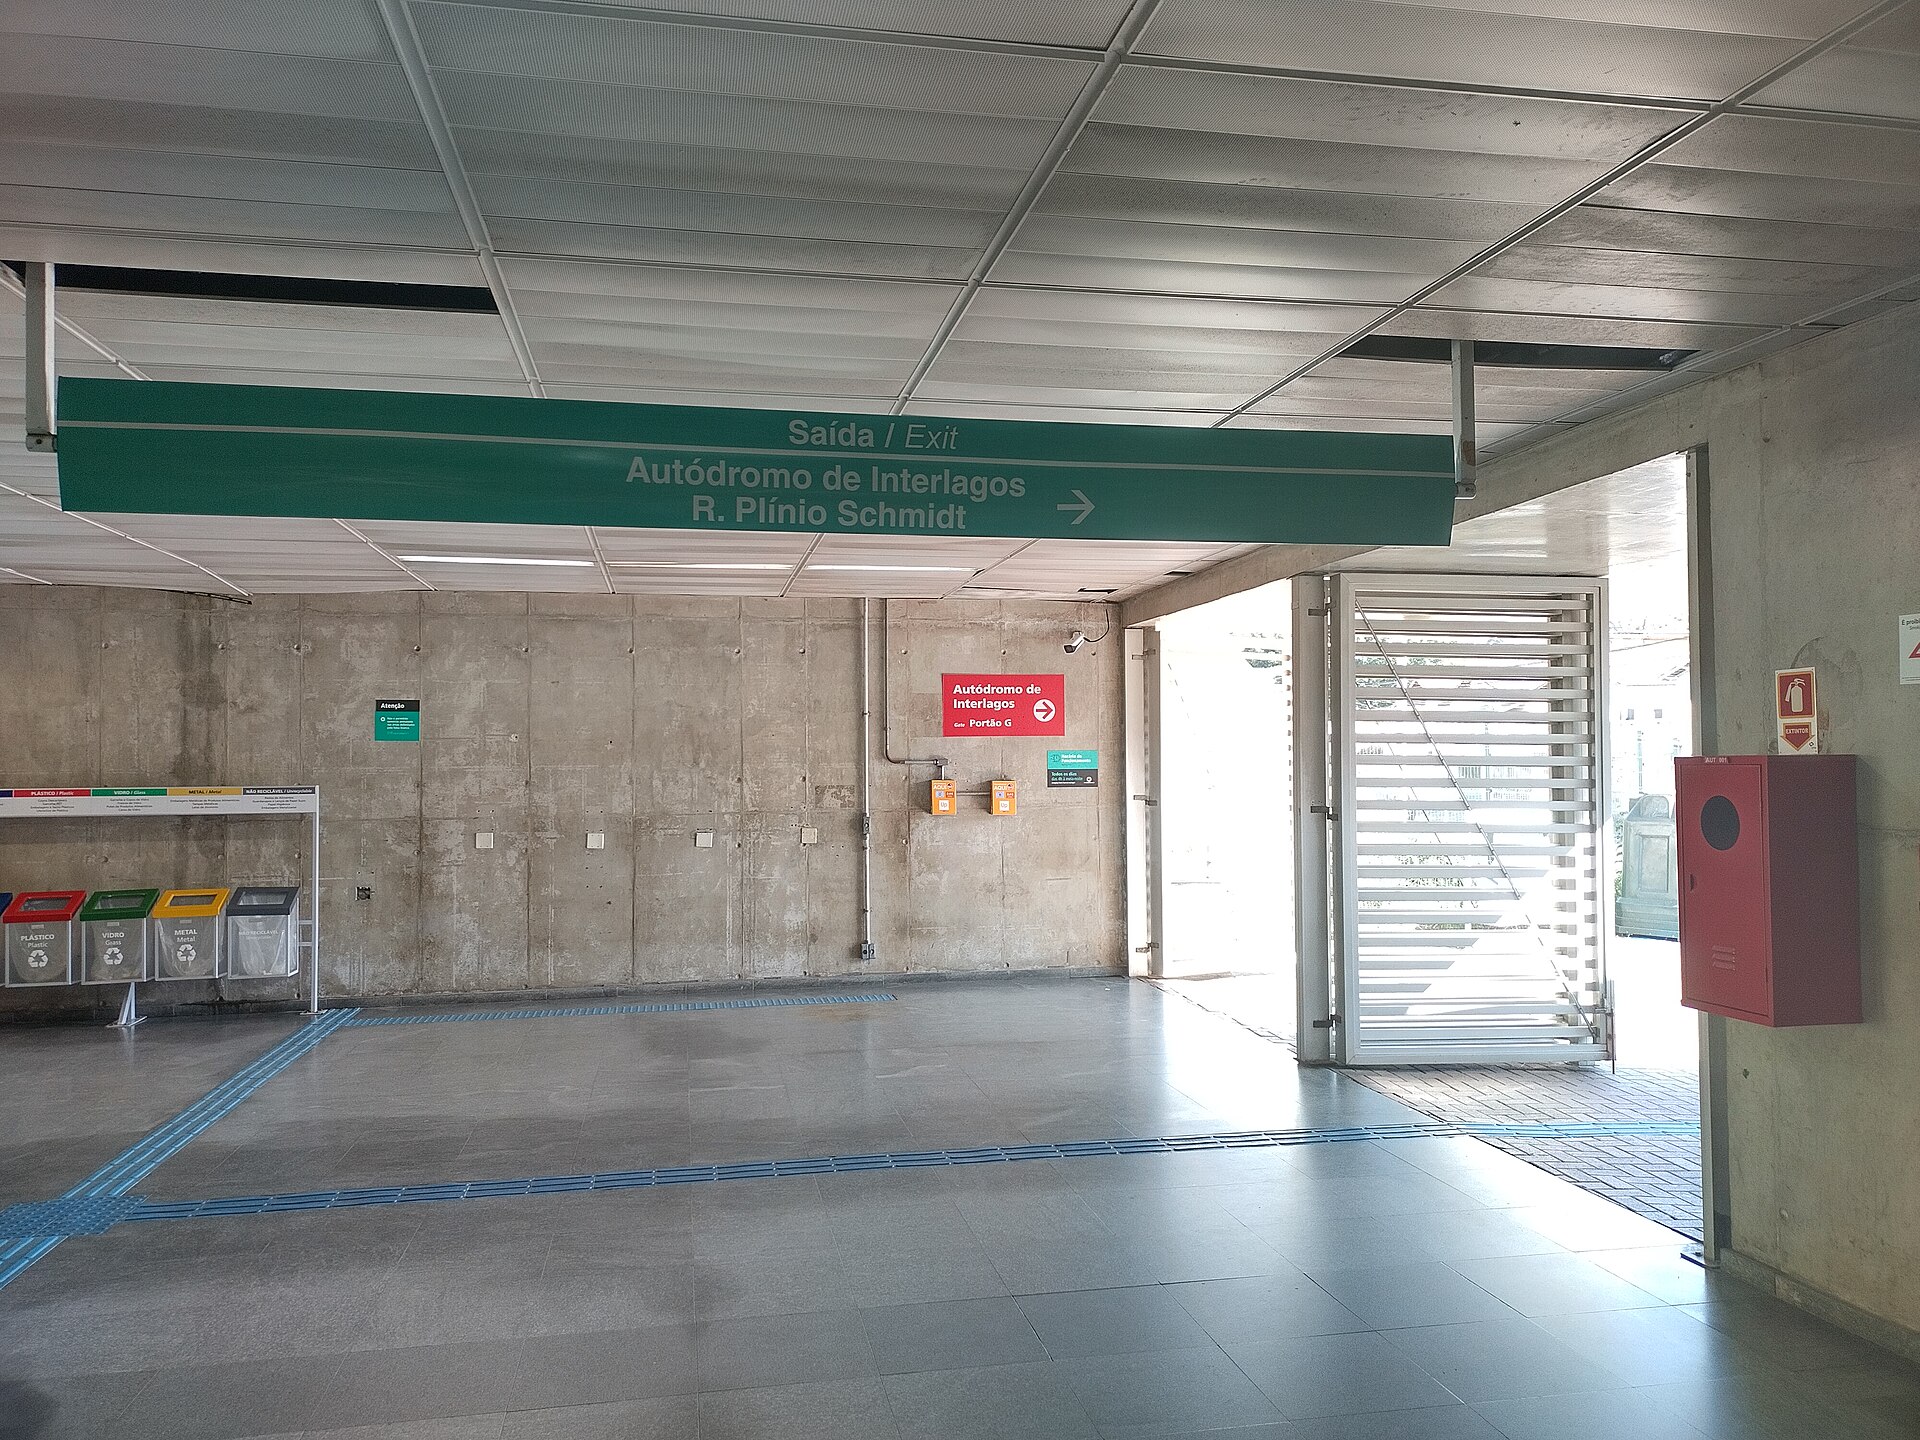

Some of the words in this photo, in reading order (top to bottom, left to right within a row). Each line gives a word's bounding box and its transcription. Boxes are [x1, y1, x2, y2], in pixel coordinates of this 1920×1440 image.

[788, 419, 875, 448] Saída
[884, 422, 896, 448] /
[905, 424, 959, 450] Exit
[626, 456, 812, 491] Autódromo
[822, 464, 861, 492] de
[871, 465, 1026, 502] Interlagos
[692, 494, 725, 522] R.
[735, 495, 827, 527] Plínio
[837, 499, 966, 530] Schmidt
[953, 682, 1024, 695] Autódromo
[1026, 683, 1042, 695] de
[380, 702, 405, 710] Atenção
[953, 698, 1016, 711] Interlagos
[969, 718, 1002, 728] Portão
[1004, 718, 1012, 728] G
